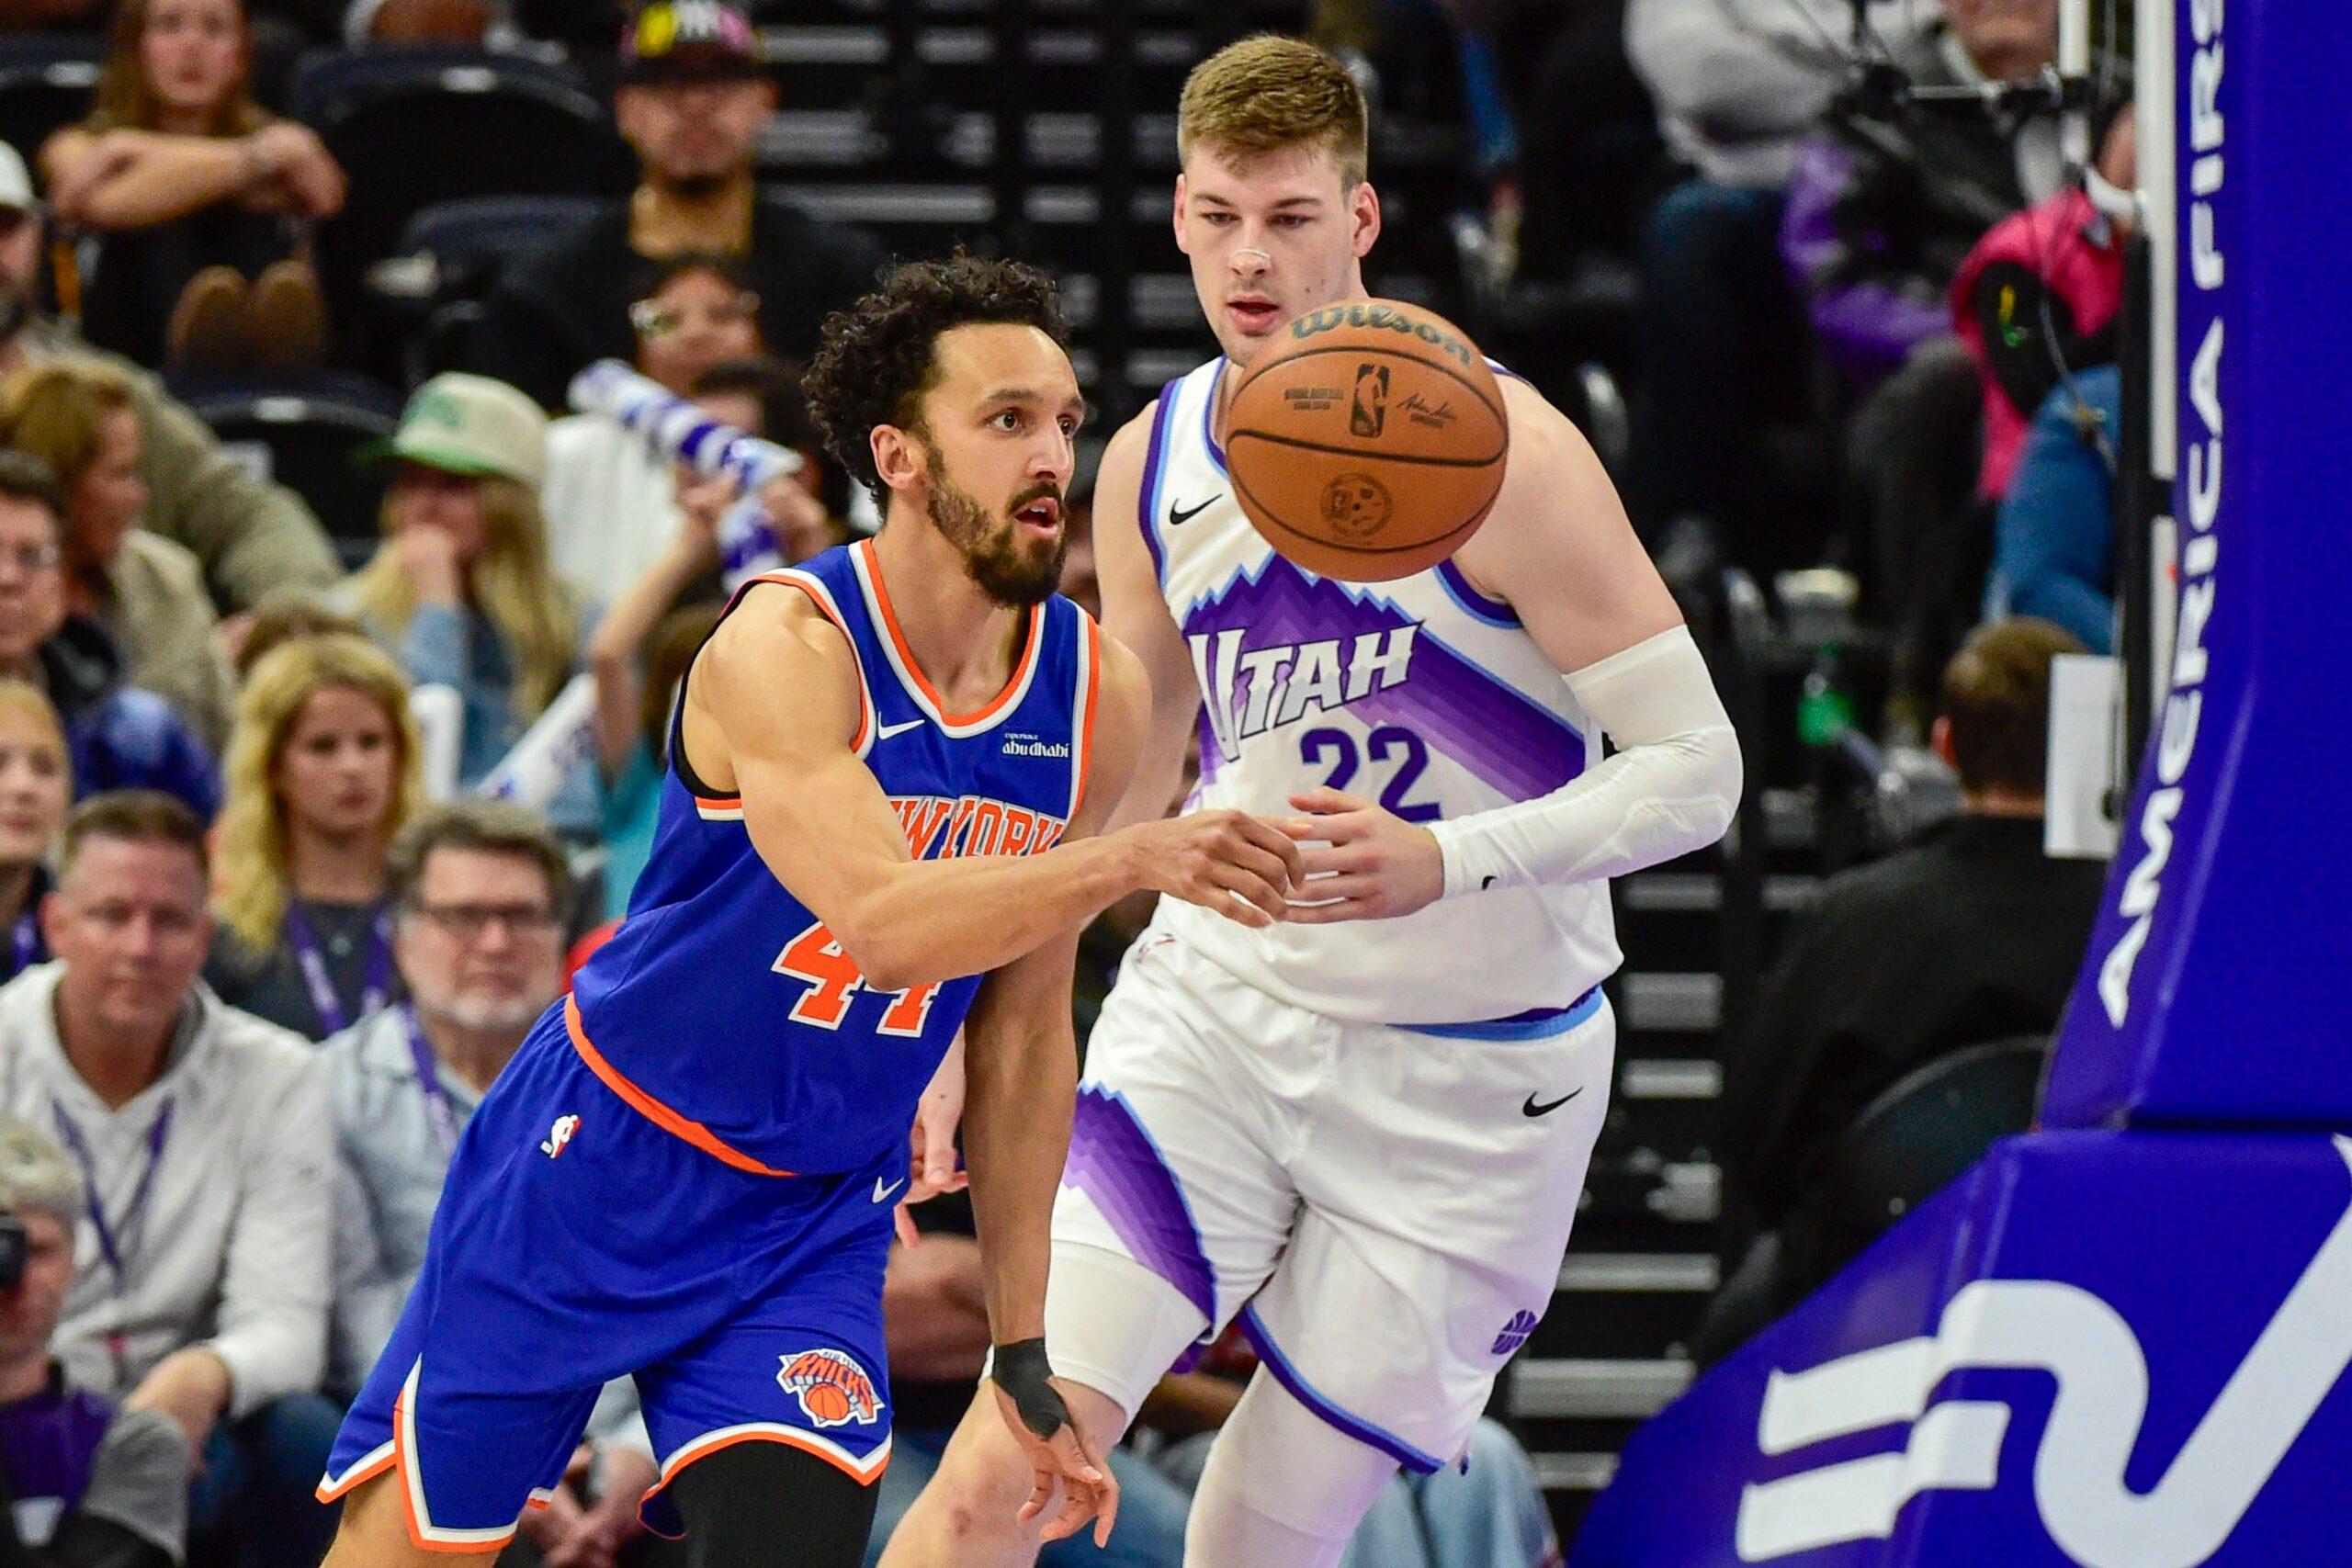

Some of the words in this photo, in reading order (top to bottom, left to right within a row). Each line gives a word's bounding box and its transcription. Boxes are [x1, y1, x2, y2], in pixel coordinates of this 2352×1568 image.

[1291, 304, 1471, 365] Wilson
[1186, 618, 1427, 763] UTAH
[2098, 316, 2224, 1028] AMERICA
[1001, 740, 1028, 756] abu
[1029, 741, 1069, 758] dhabi
[1300, 725, 1443, 823] 22
[781, 1352, 874, 1419] KNICKS
